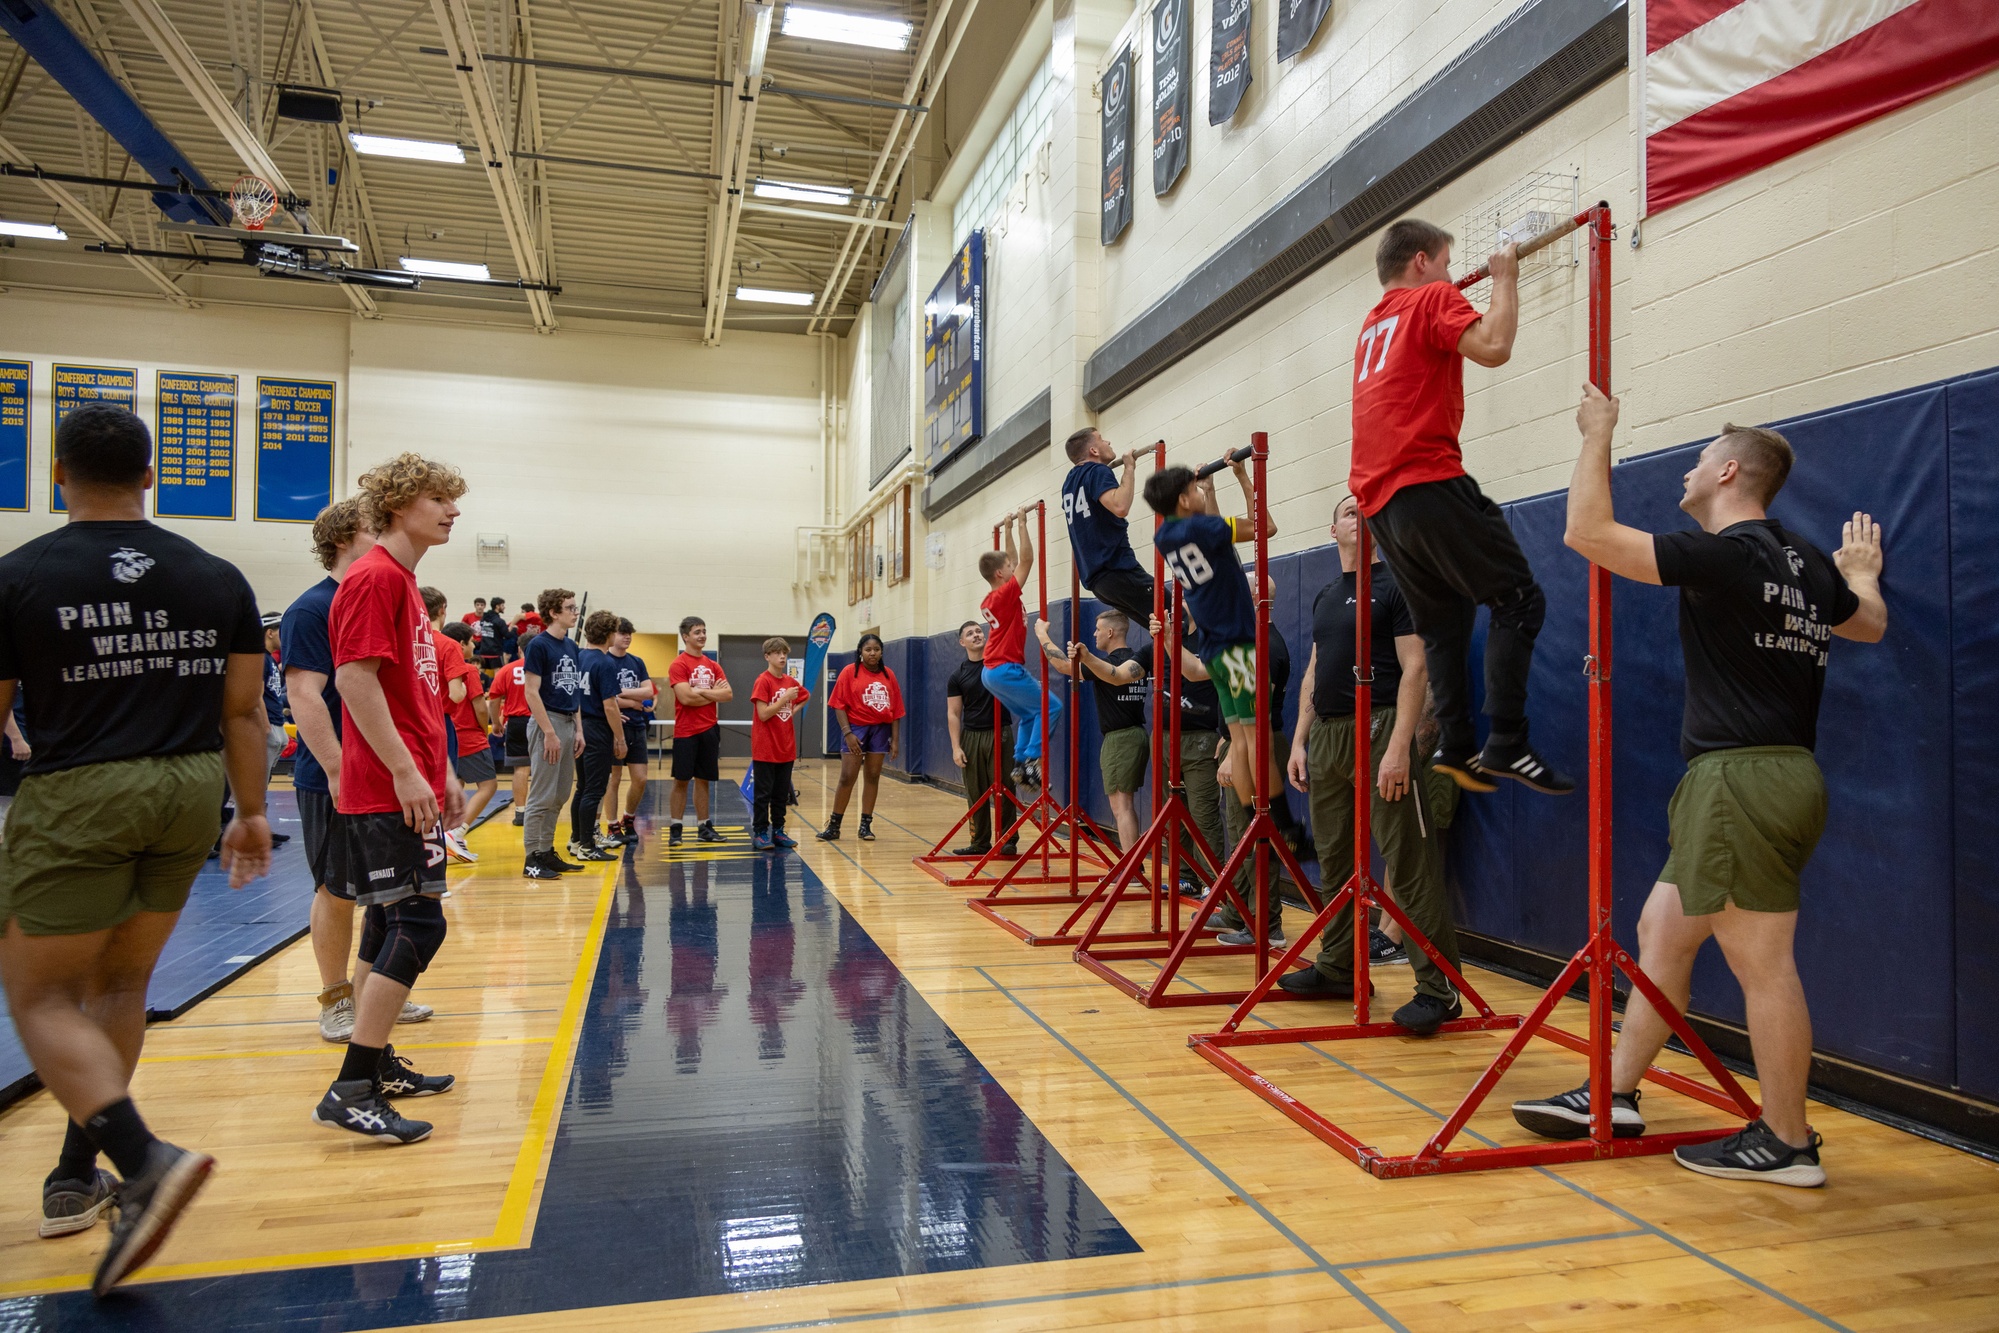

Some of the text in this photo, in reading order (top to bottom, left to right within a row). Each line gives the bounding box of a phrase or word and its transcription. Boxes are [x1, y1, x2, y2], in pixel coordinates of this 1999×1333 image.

[1358, 314, 1400, 384] 77
[57, 371, 133, 387] CONFERENCE CHAMPIONS
[161, 378, 234, 393] CONFERENCE CHAMPIONS
[57, 385, 131, 401] BOYS CROSS COUNTRY
[261, 384, 332, 400] CONFERENCE CHAMPIONS
[162, 391, 233, 407] GIRLS CROSS COUNTRY
[271, 398, 321, 412] BOYS SOCCER
[2, 407, 24, 416] 2012
[187, 408, 207, 416] 1987
[286, 413, 306, 422] 1987
[309, 415, 328, 423] 1991
[2, 417, 24, 426] 2015
[186, 418, 207, 426] 1992
[210, 420, 231, 428] 1993
[162, 426, 230, 438] 1994 1995 1996
[285, 433, 305, 442] 2011
[308, 434, 328, 443] 2012
[162, 436, 183, 445] 1997
[210, 440, 230, 448] 1999
[262, 442, 282, 450] 2014
[162, 446, 230, 458] 2000 2001 2002
[162, 456, 230, 468] 2003 2004 2005
[186, 468, 206, 476] 2007
[186, 478, 206, 486] 2010
[1063, 485, 1091, 526] 94
[1166, 542, 1214, 590] 58
[1763, 582, 1806, 611] PAIN
[57, 602, 169, 630] PAIN IS
[92, 629, 218, 656] WEAKNESS
[62, 658, 144, 683] LEAVING
[147, 656, 174, 669] THE
